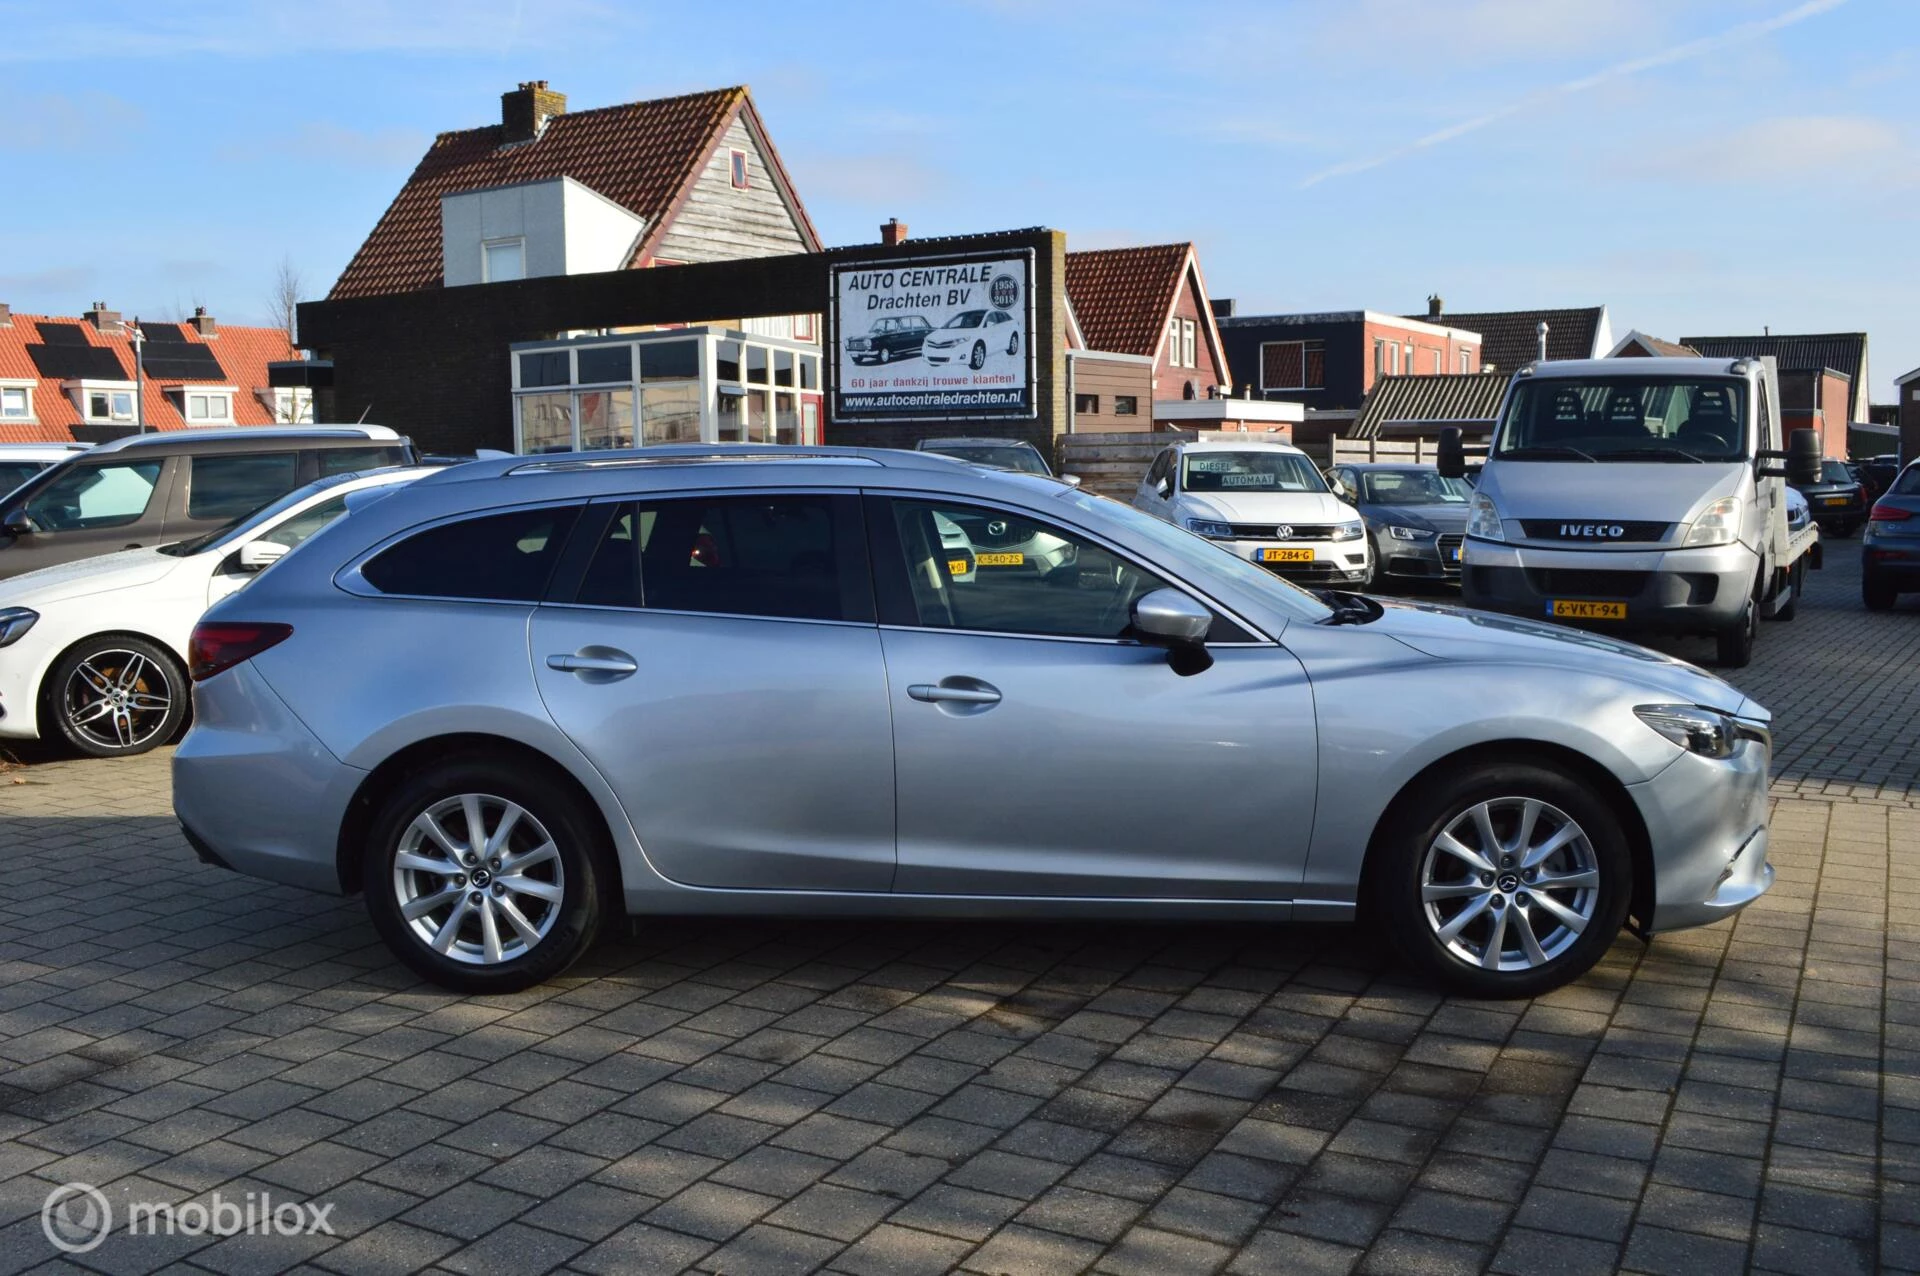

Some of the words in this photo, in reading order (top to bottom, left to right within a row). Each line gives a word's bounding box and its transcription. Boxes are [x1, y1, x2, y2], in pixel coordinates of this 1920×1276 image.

[849, 273, 894, 291] AUTO
[900, 265, 993, 288] CENTRALE
[994, 281, 1015, 290] 1958
[867, 293, 942, 311] Drachten
[947, 288, 971, 306] BV
[994, 295, 1015, 305] 2018
[851, 379, 865, 389] 60
[869, 378, 889, 389] jaar
[893, 376, 929, 388] dankzij
[933, 375, 969, 386] trouwe
[973, 373, 1016, 384] klanten!
[845, 390, 1022, 407] www.autocentraledrachten.nl
[1200, 462, 1231, 472] DIESEL
[1222, 475, 1273, 485] AUTOMAAT
[1560, 524, 1625, 537] IVECO
[1266, 551, 1310, 560] JT-284-G
[1557, 603, 1619, 616] 6-VKT-94
